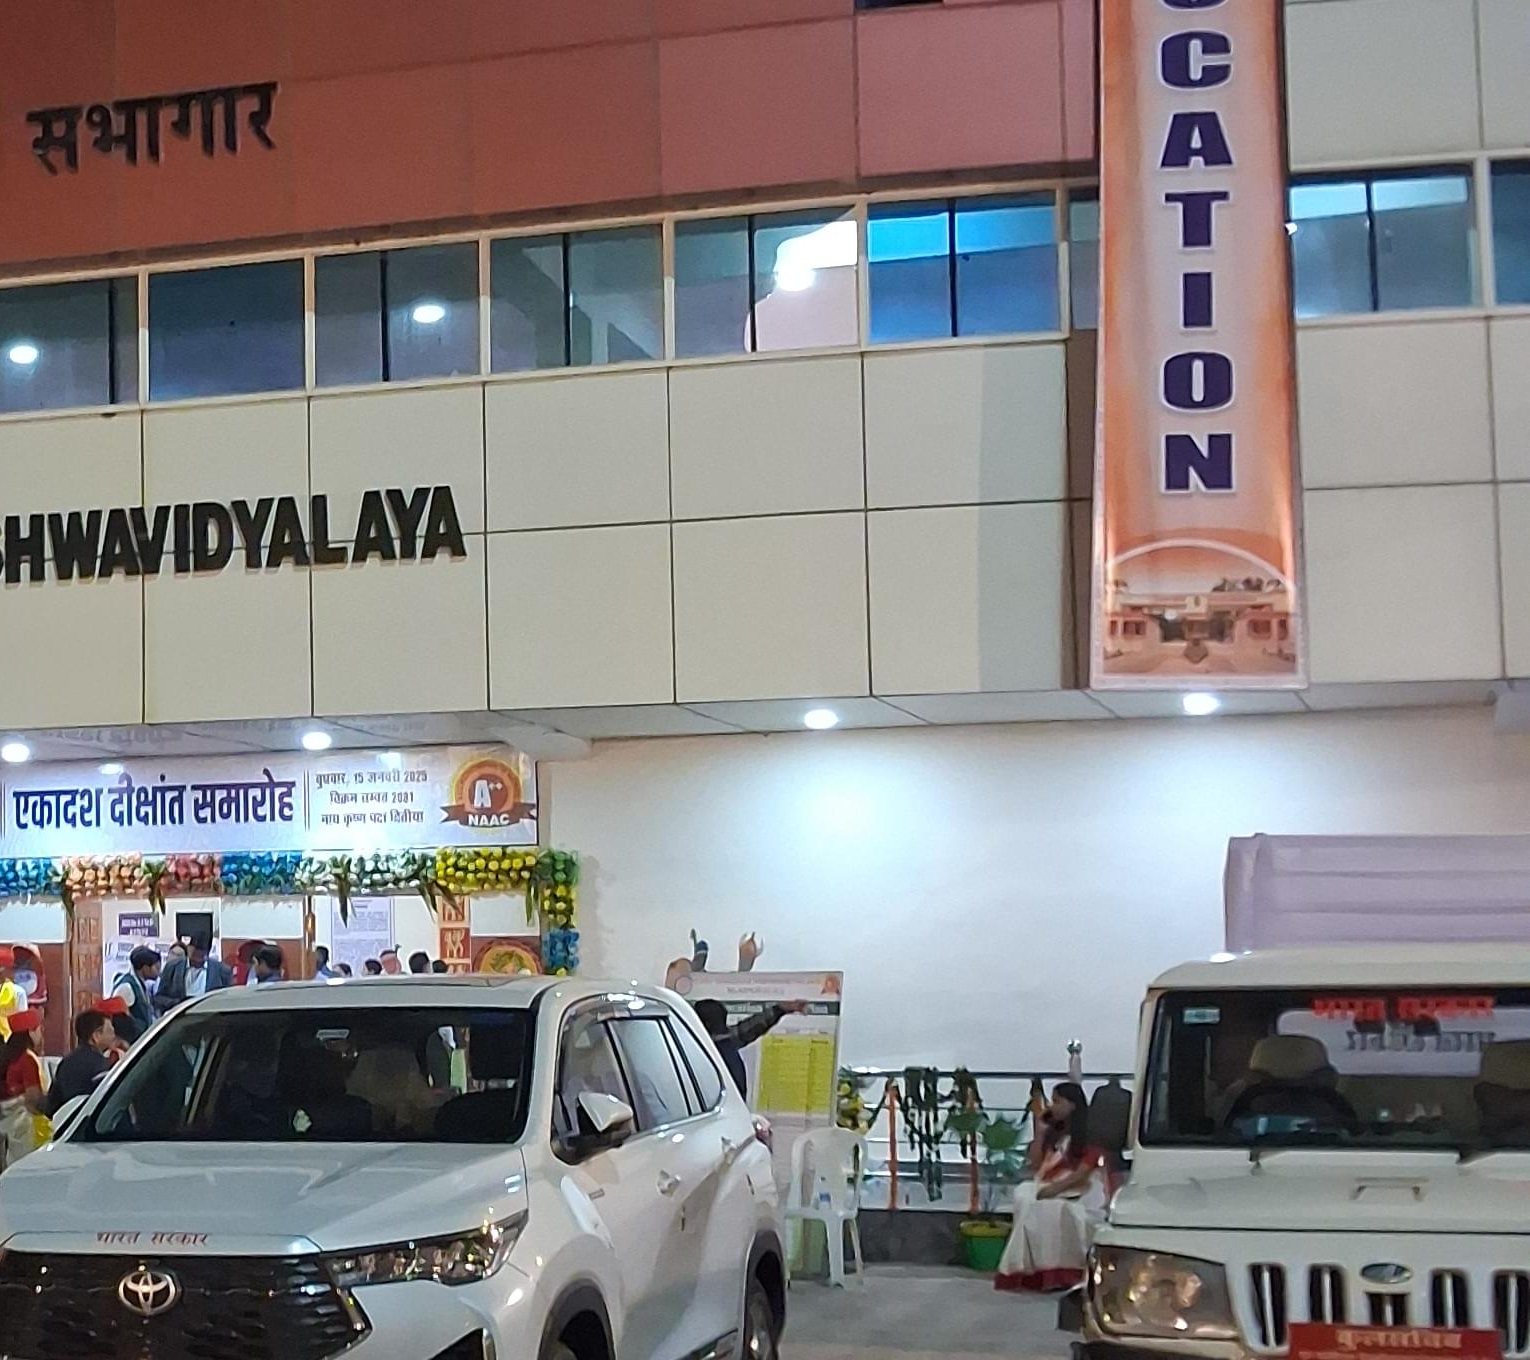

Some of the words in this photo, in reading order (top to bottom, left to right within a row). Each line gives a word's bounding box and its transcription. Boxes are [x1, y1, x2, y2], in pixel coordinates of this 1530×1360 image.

[26, 81, 278, 175] सभागार
[354, 772, 364, 784] 15
[367, 768, 401, 783] जनवरी
[404, 769, 428, 782] 2025
[13, 788, 103, 829] एकादश
[107, 772, 186, 827] दीक्षांत
[191, 767, 296, 825] समारोह
[468, 814, 510, 825] NAAC
[97, 1231, 141, 1244] भारत
[151, 1231, 212, 1245] सरकार
